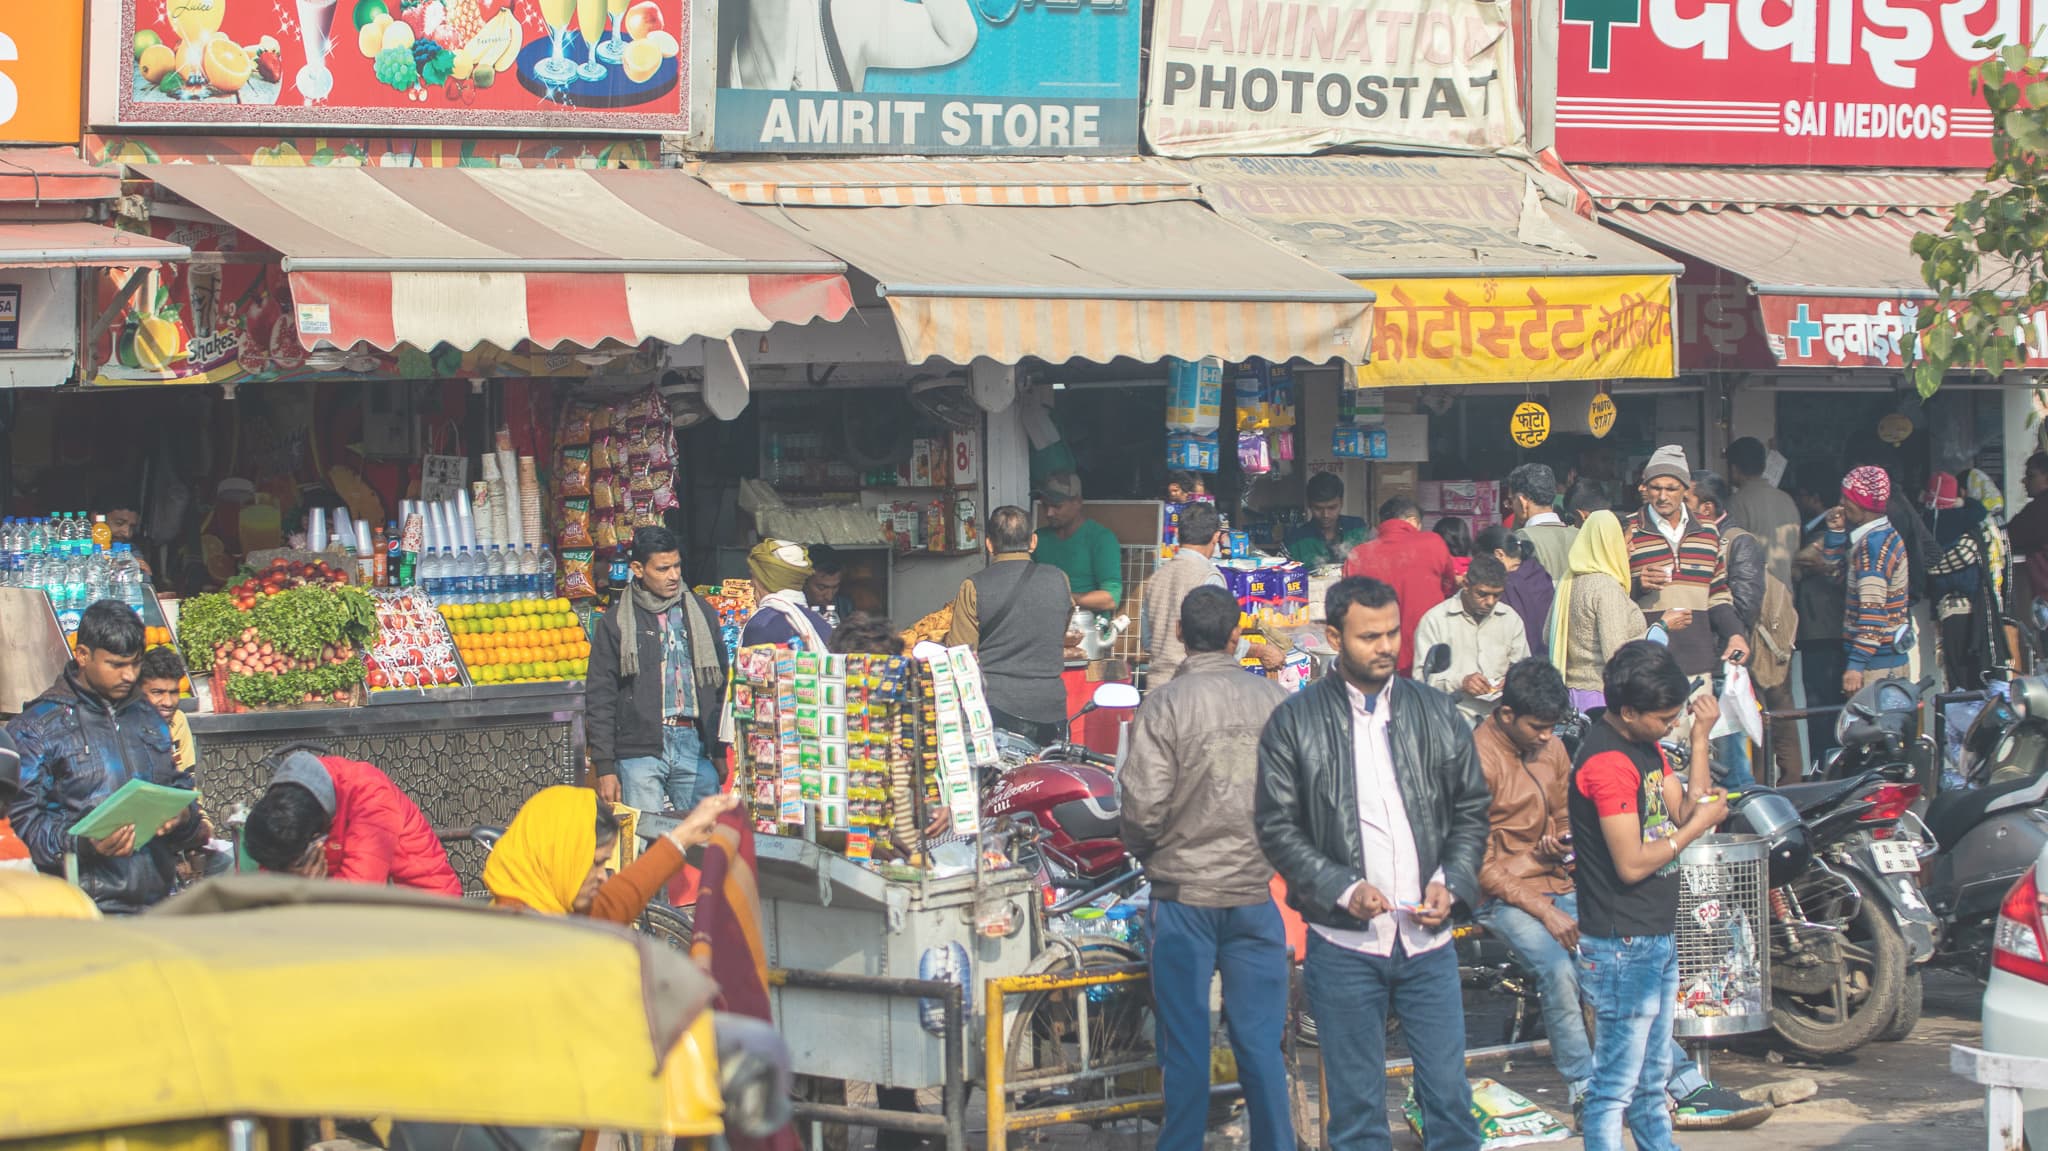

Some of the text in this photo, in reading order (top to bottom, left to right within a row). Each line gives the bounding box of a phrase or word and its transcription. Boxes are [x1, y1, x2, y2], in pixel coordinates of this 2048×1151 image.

[1163, 61, 1498, 119] PHOTOSTAT
[759, 98, 1100, 147] AMRIT STORE
[1783, 100, 1947, 140] SAI MEDICOS
[1592, 400, 1612, 414] PHOTO
